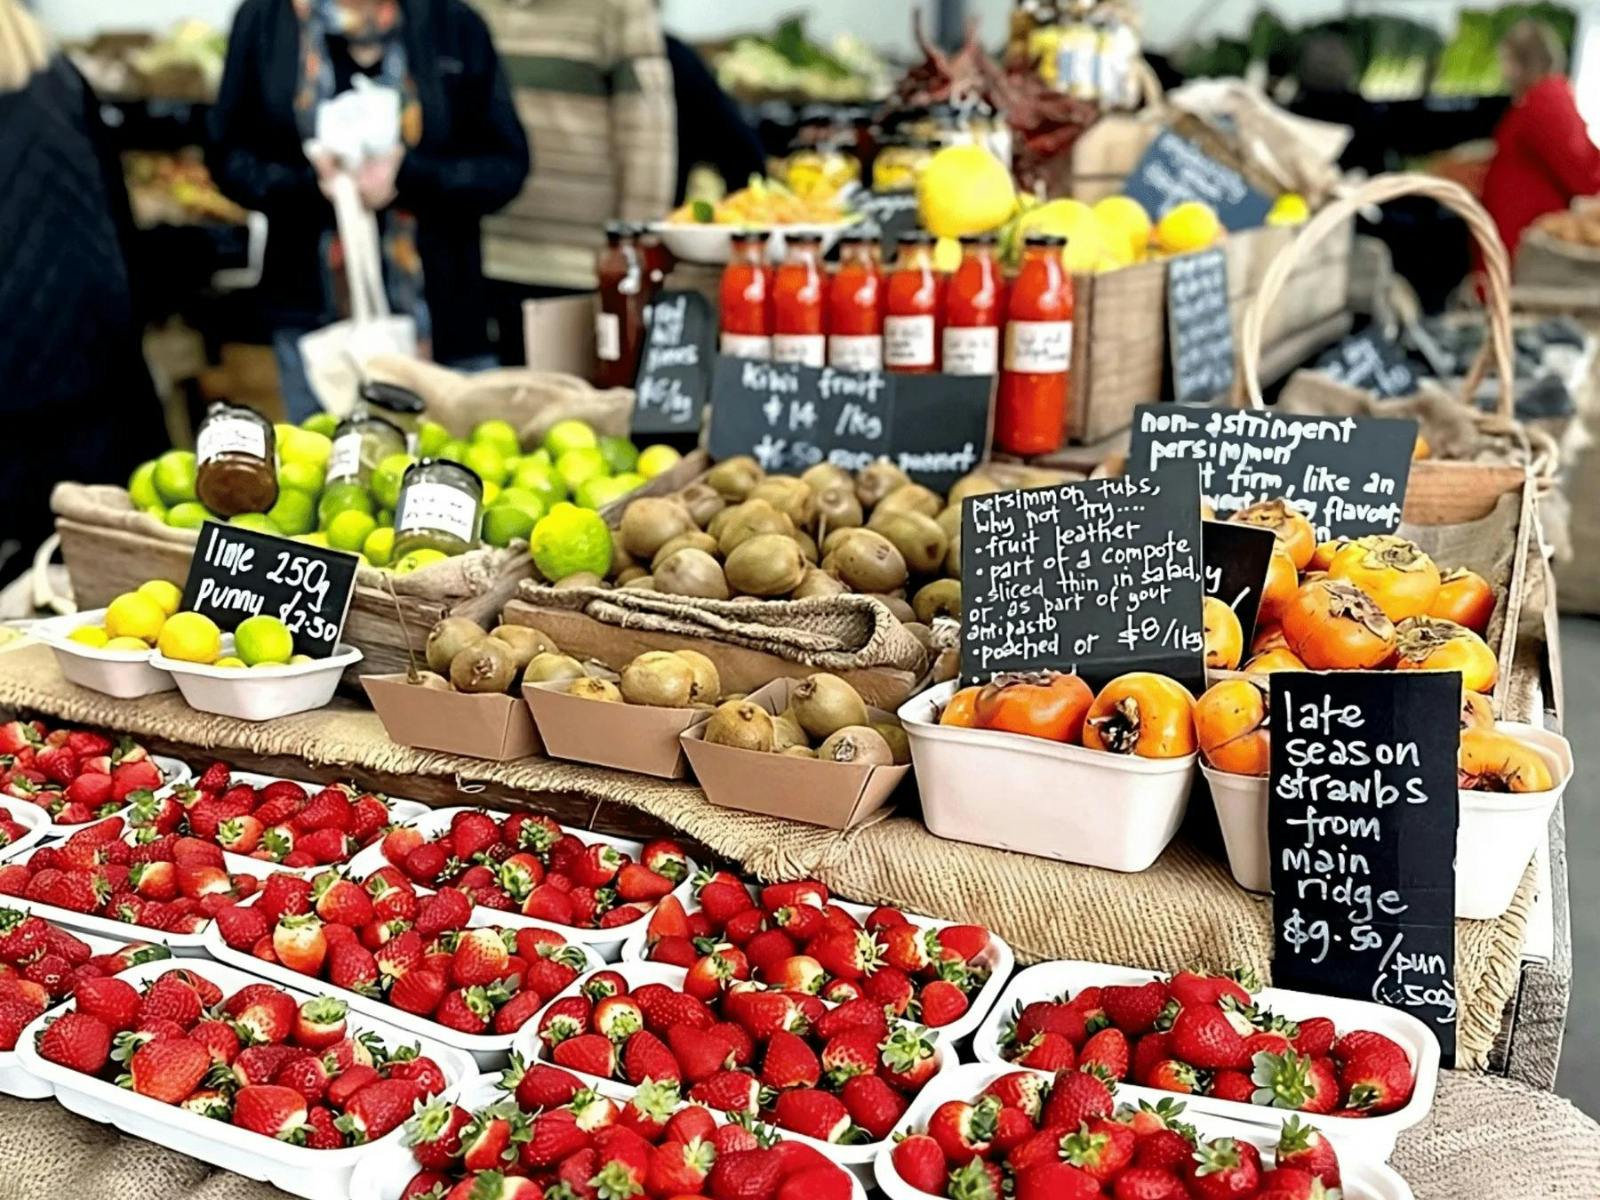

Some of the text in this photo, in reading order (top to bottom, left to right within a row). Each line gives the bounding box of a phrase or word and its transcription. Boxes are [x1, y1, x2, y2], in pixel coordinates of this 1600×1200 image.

[817, 367, 884, 402] fruit
[1151, 439, 1292, 471] persimmon
[1303, 465, 1351, 493] like
[1363, 473, 1395, 495] an
[973, 475, 1160, 524] persimmon tubs,
[976, 510, 1015, 538] why
[1026, 504, 1060, 529] not
[985, 518, 1141, 557] fruit leather
[204, 527, 330, 613] lime 250g
[990, 530, 1191, 588] part of a compote
[987, 577, 1044, 602] sliced
[1057, 569, 1099, 594] thin
[1114, 566, 1134, 589] in
[969, 605, 994, 624] or
[1008, 601, 1031, 618] as
[1044, 592, 1084, 619] part
[1096, 586, 1119, 612] of
[1074, 634, 1099, 655] or
[1283, 691, 1366, 735] late
[1286, 738, 1421, 768] season
[1276, 768, 1429, 808] strawbs
[1286, 805, 1381, 847] from
[1297, 873, 1408, 924] ridge
